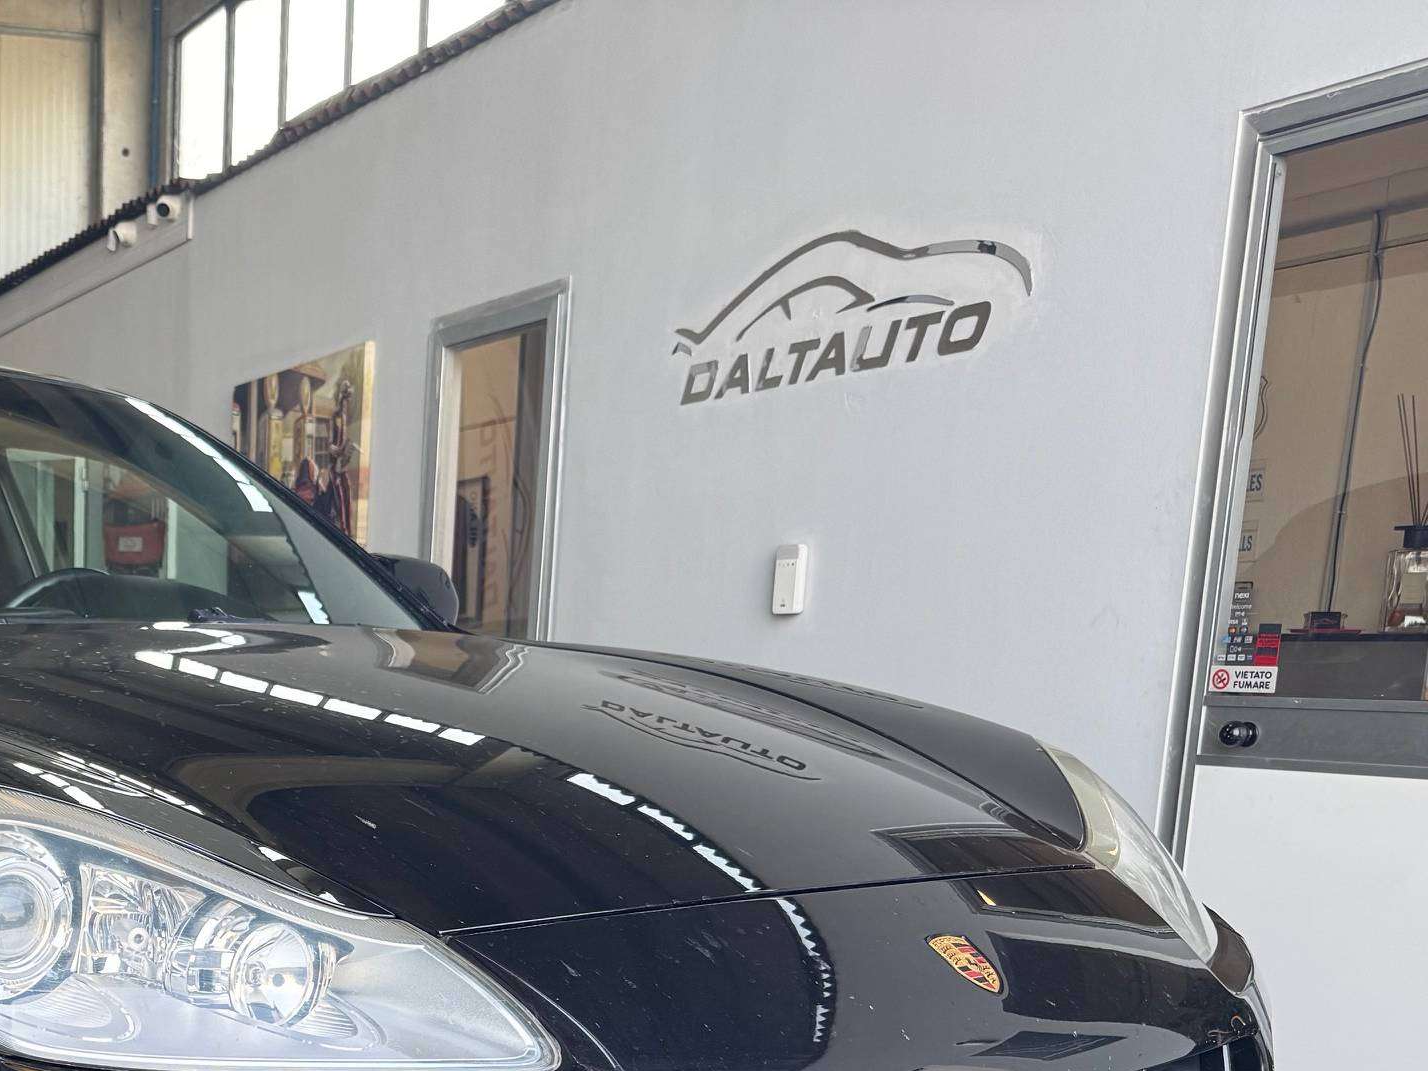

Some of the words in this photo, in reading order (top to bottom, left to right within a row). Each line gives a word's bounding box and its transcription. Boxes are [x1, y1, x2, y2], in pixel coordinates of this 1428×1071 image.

[680, 301, 992, 405] DALTAUTO
[1234, 671, 1273, 680] VIETATO
[1233, 681, 1271, 689] FUMARE
